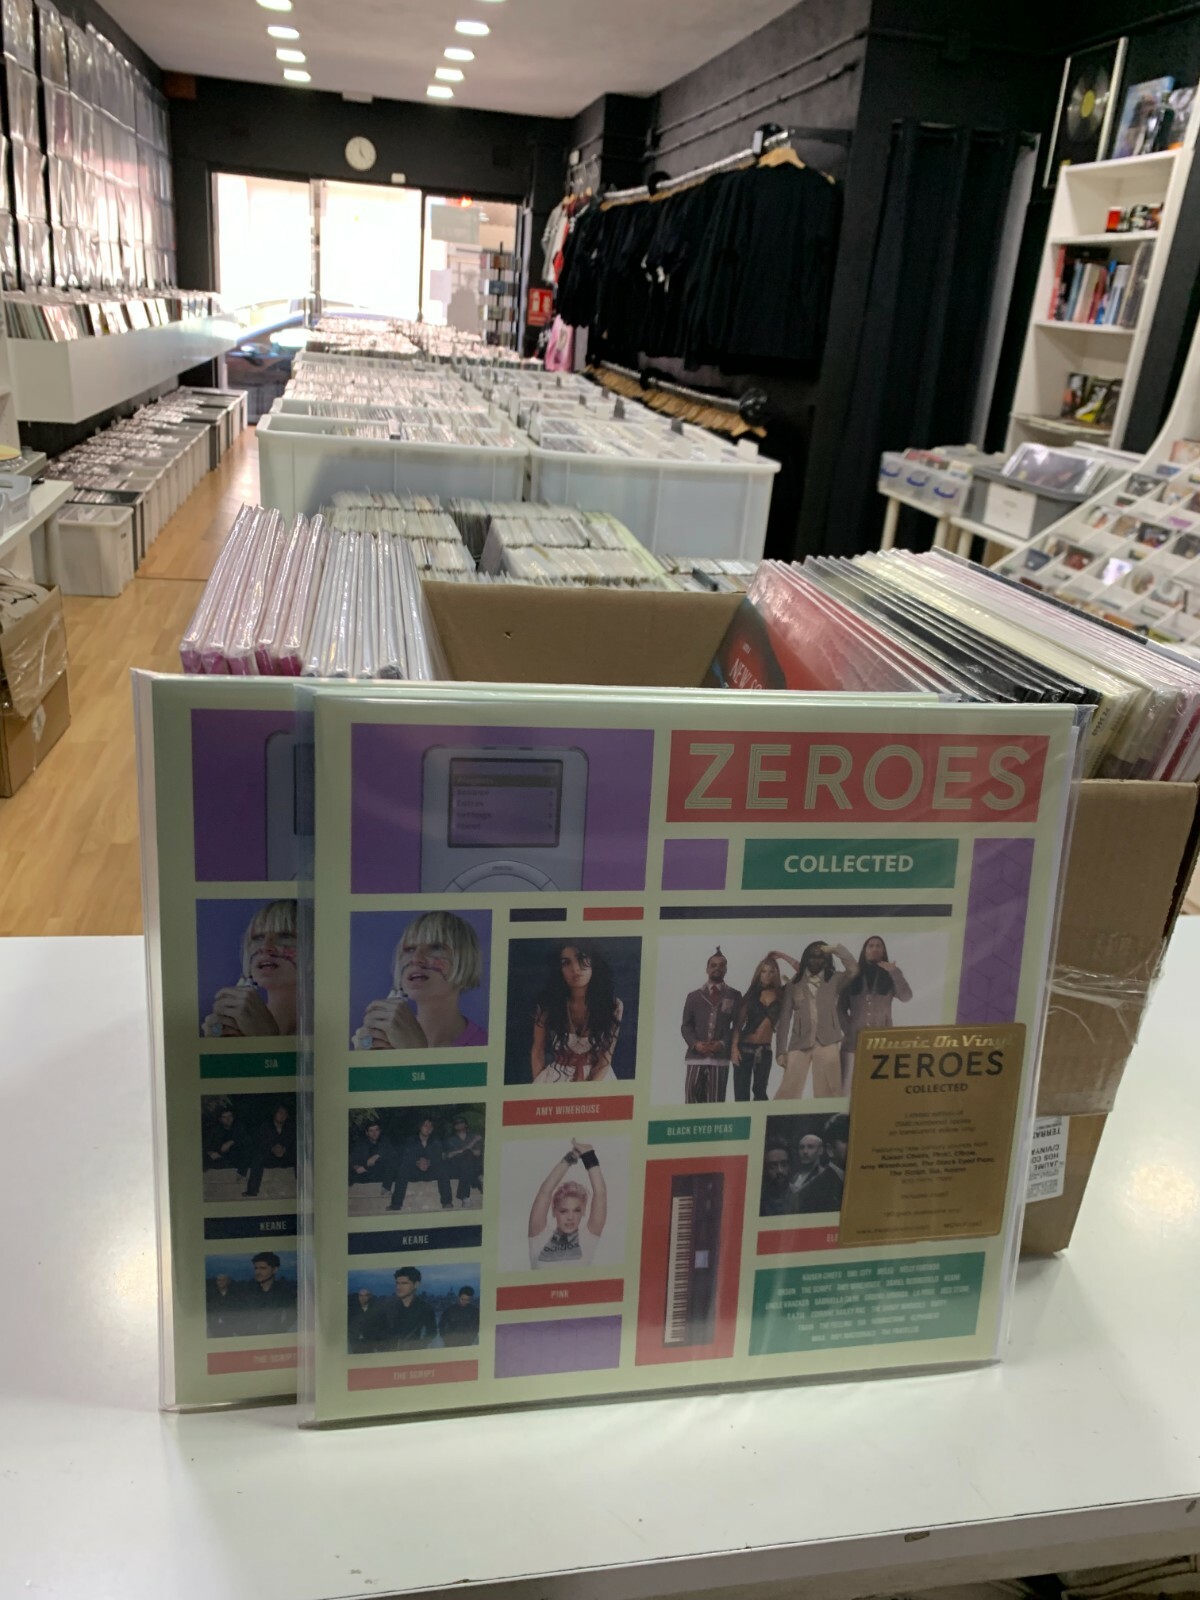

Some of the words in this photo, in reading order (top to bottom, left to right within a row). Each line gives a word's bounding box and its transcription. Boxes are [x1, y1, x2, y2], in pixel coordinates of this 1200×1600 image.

[684, 743, 1031, 811] ZEROES
[783, 854, 914, 873] COLLECTED
[866, 1036, 930, 1050] Music
[933, 1035, 960, 1048] On
[963, 1034, 1012, 1049] Vinyl
[264, 1058, 278, 1069] SIA
[870, 1050, 1004, 1079] ZEROES
[412, 1071, 426, 1082] SIA
[905, 1083, 968, 1094] COLLECTED
[536, 1106, 552, 1116] AMY
[555, 1104, 601, 1115] WINEHOUSE
[667, 1126, 691, 1136] BLACK
[714, 1124, 733, 1134] PEAS
[259, 1221, 287, 1231] KEANE
[402, 1235, 429, 1245] KEANE
